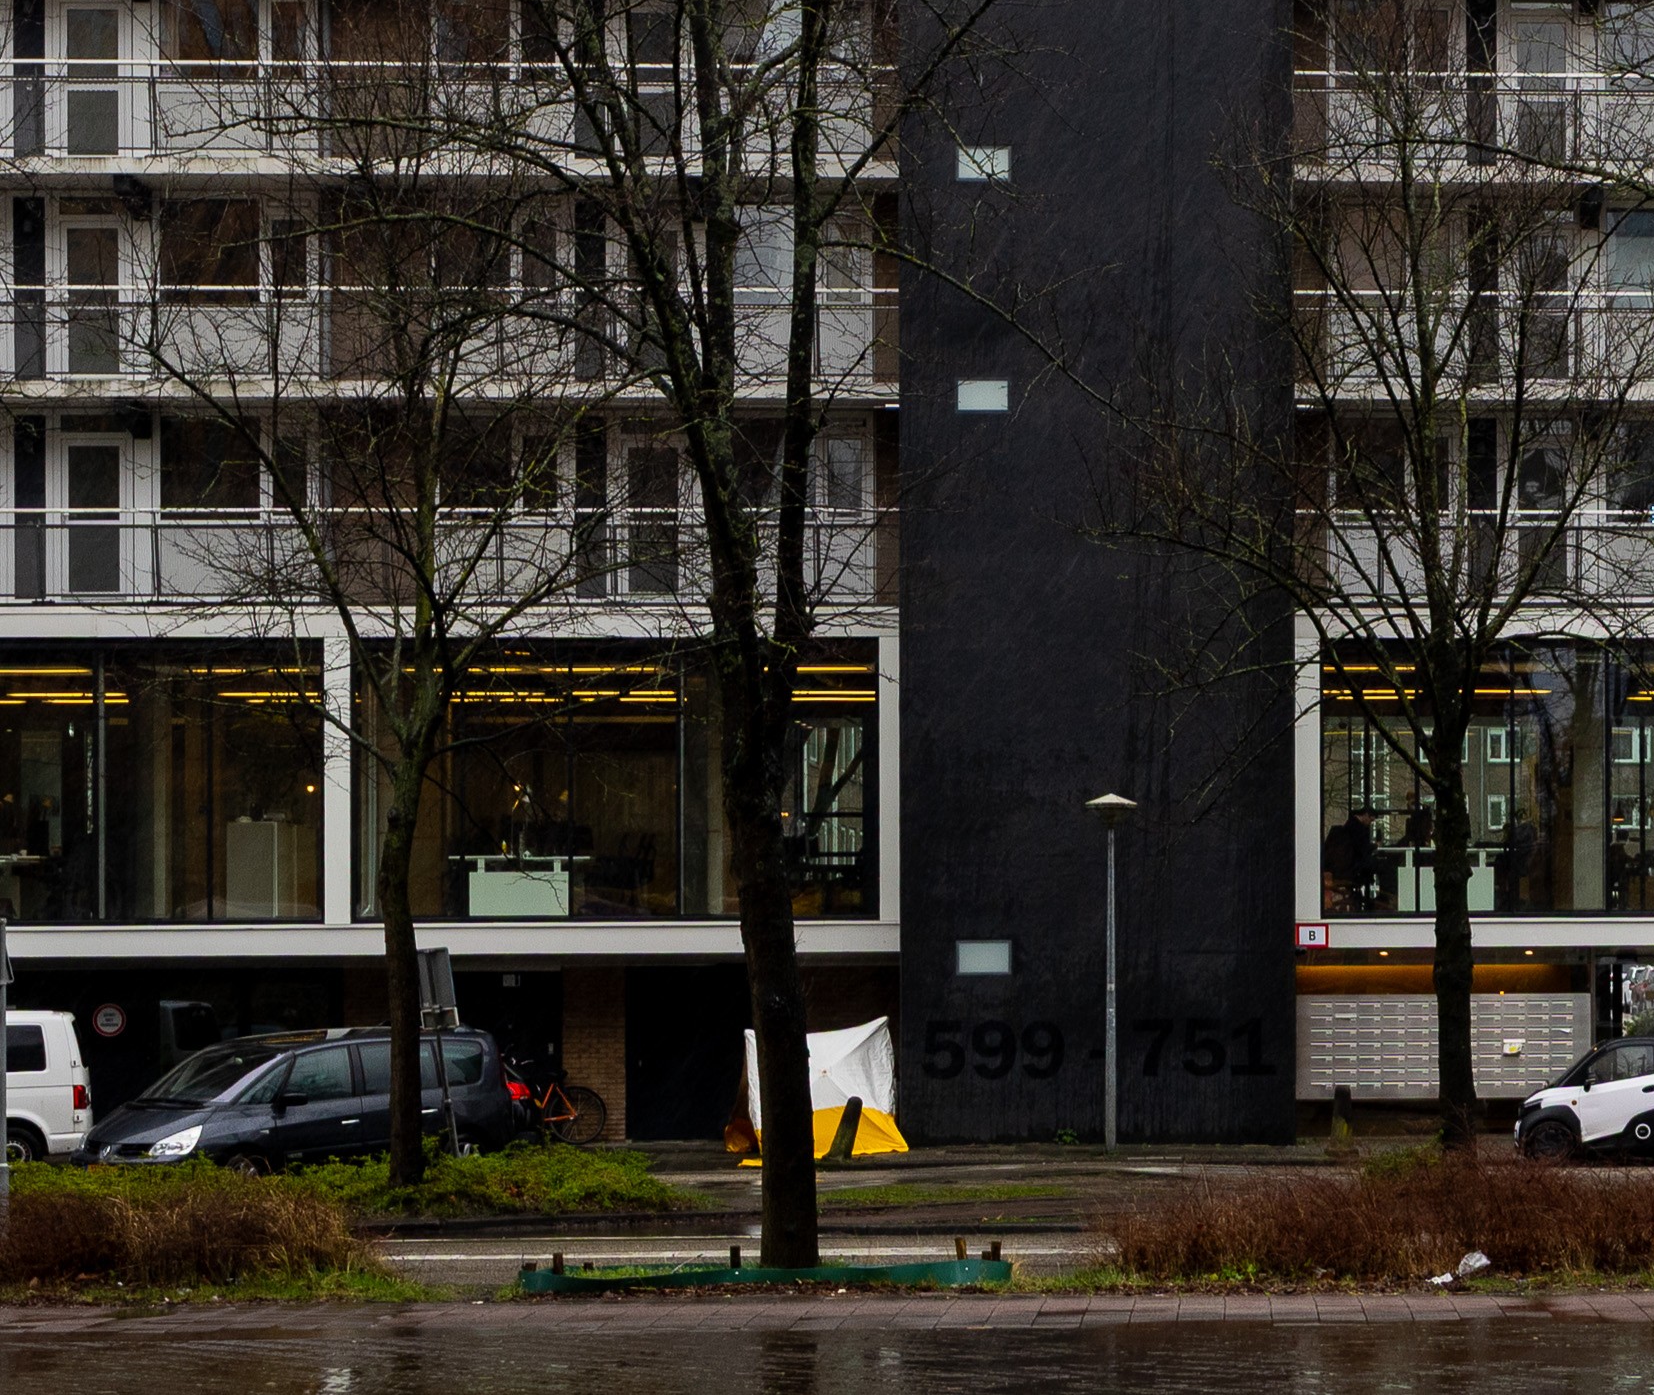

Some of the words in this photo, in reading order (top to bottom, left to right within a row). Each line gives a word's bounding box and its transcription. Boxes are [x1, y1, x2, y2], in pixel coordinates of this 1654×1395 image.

[1308, 930, 1317, 941] B
[921, 1020, 1066, 1079] 599
[1132, 1017, 1277, 1077] 751
